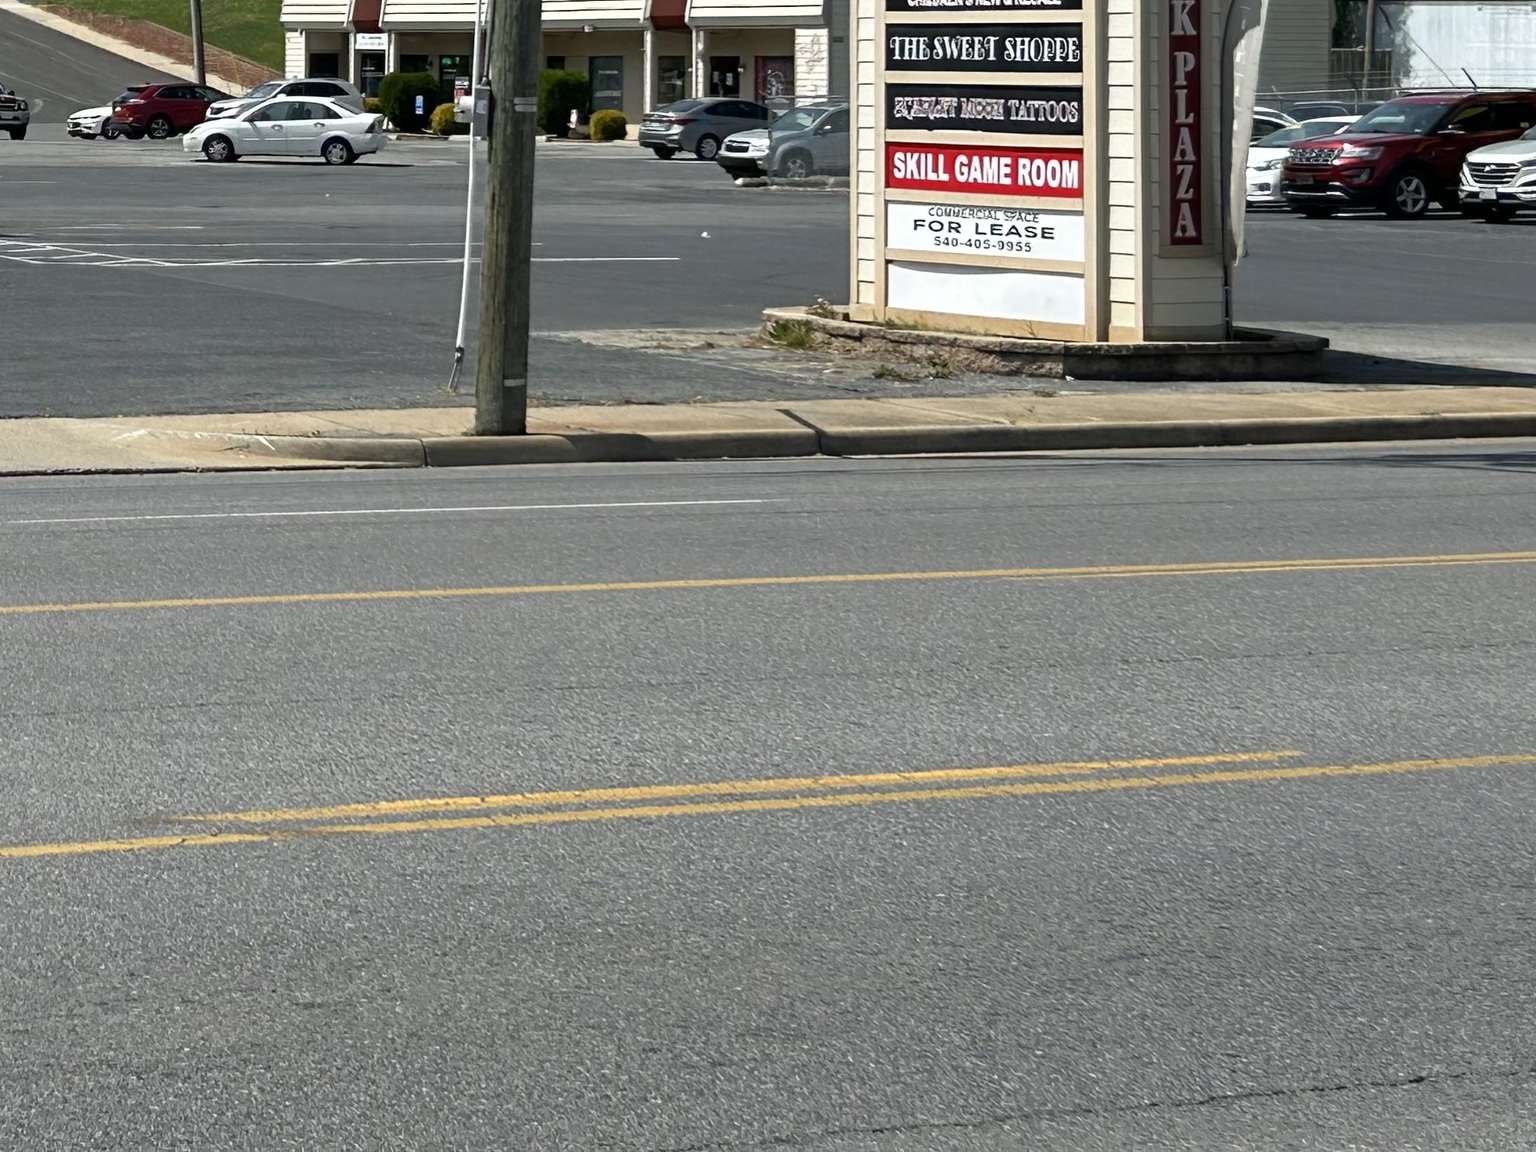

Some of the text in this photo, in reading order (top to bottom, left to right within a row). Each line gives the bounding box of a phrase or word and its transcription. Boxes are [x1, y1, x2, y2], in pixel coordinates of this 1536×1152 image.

[890, 35, 1080, 63] THE SWEET SHOPPE
[1007, 99, 1079, 123] TATTOOS
[1174, 51, 1197, 238] PLAZA
[893, 151, 1079, 189] SKILL GAME ROOM
[928, 206, 1000, 221] COMMERCIAL
[913, 219, 1056, 240] FOR LEASE
